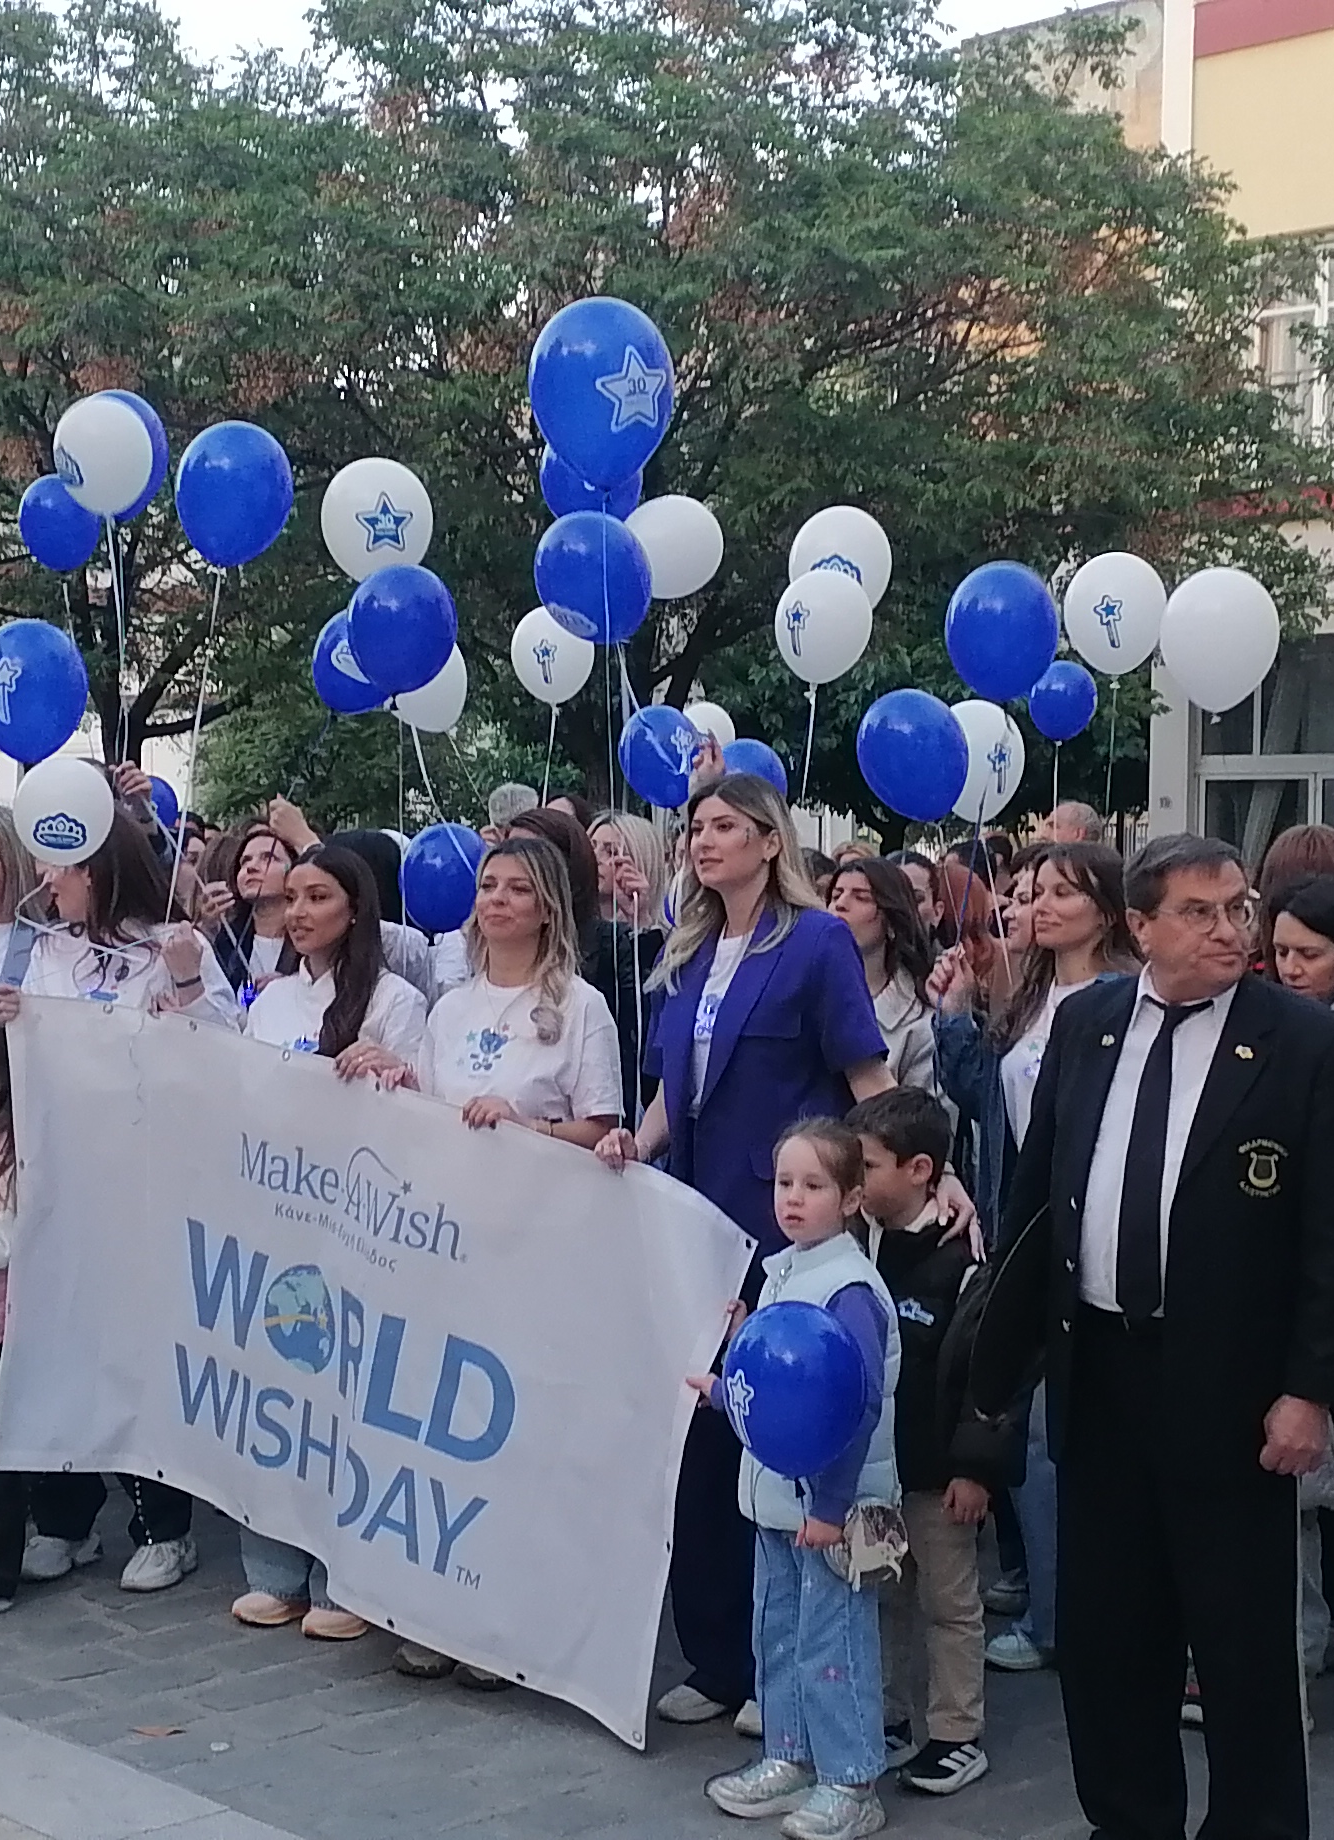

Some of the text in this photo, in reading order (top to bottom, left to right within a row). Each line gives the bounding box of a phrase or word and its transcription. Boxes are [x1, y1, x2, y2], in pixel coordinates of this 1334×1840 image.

[175, 1341, 338, 1497] WISH
[336, 1435, 489, 1577] DAY
[186, 1216, 516, 1463] WORLD
